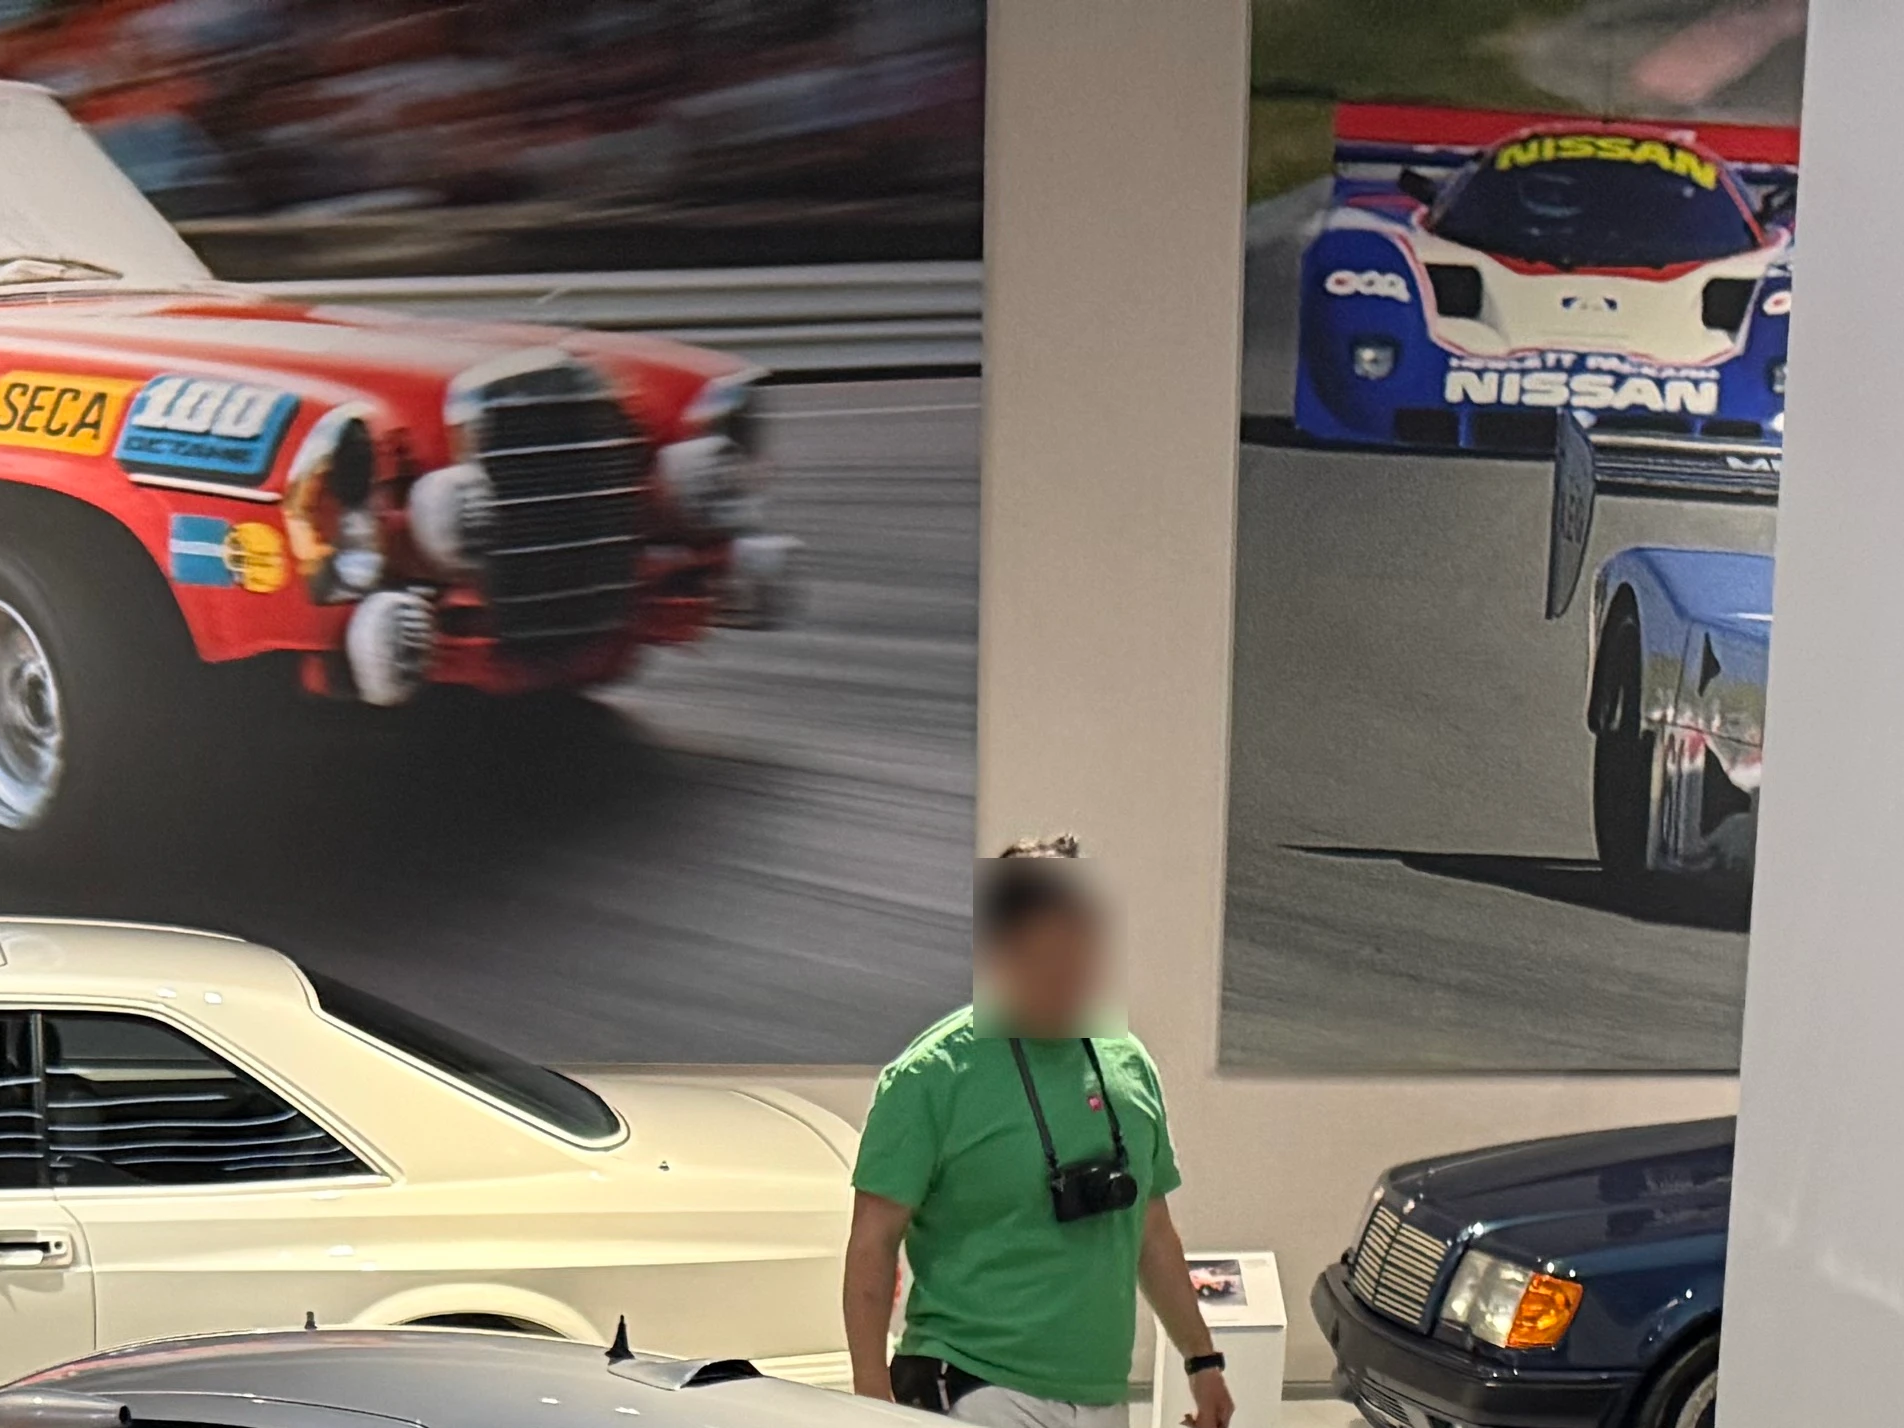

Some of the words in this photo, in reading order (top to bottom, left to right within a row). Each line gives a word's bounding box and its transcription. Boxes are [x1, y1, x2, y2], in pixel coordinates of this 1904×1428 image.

[1496, 135, 1717, 190] NISSAN
[130, 376, 282, 439] 100
[1445, 371, 1719, 415] NISSAN
